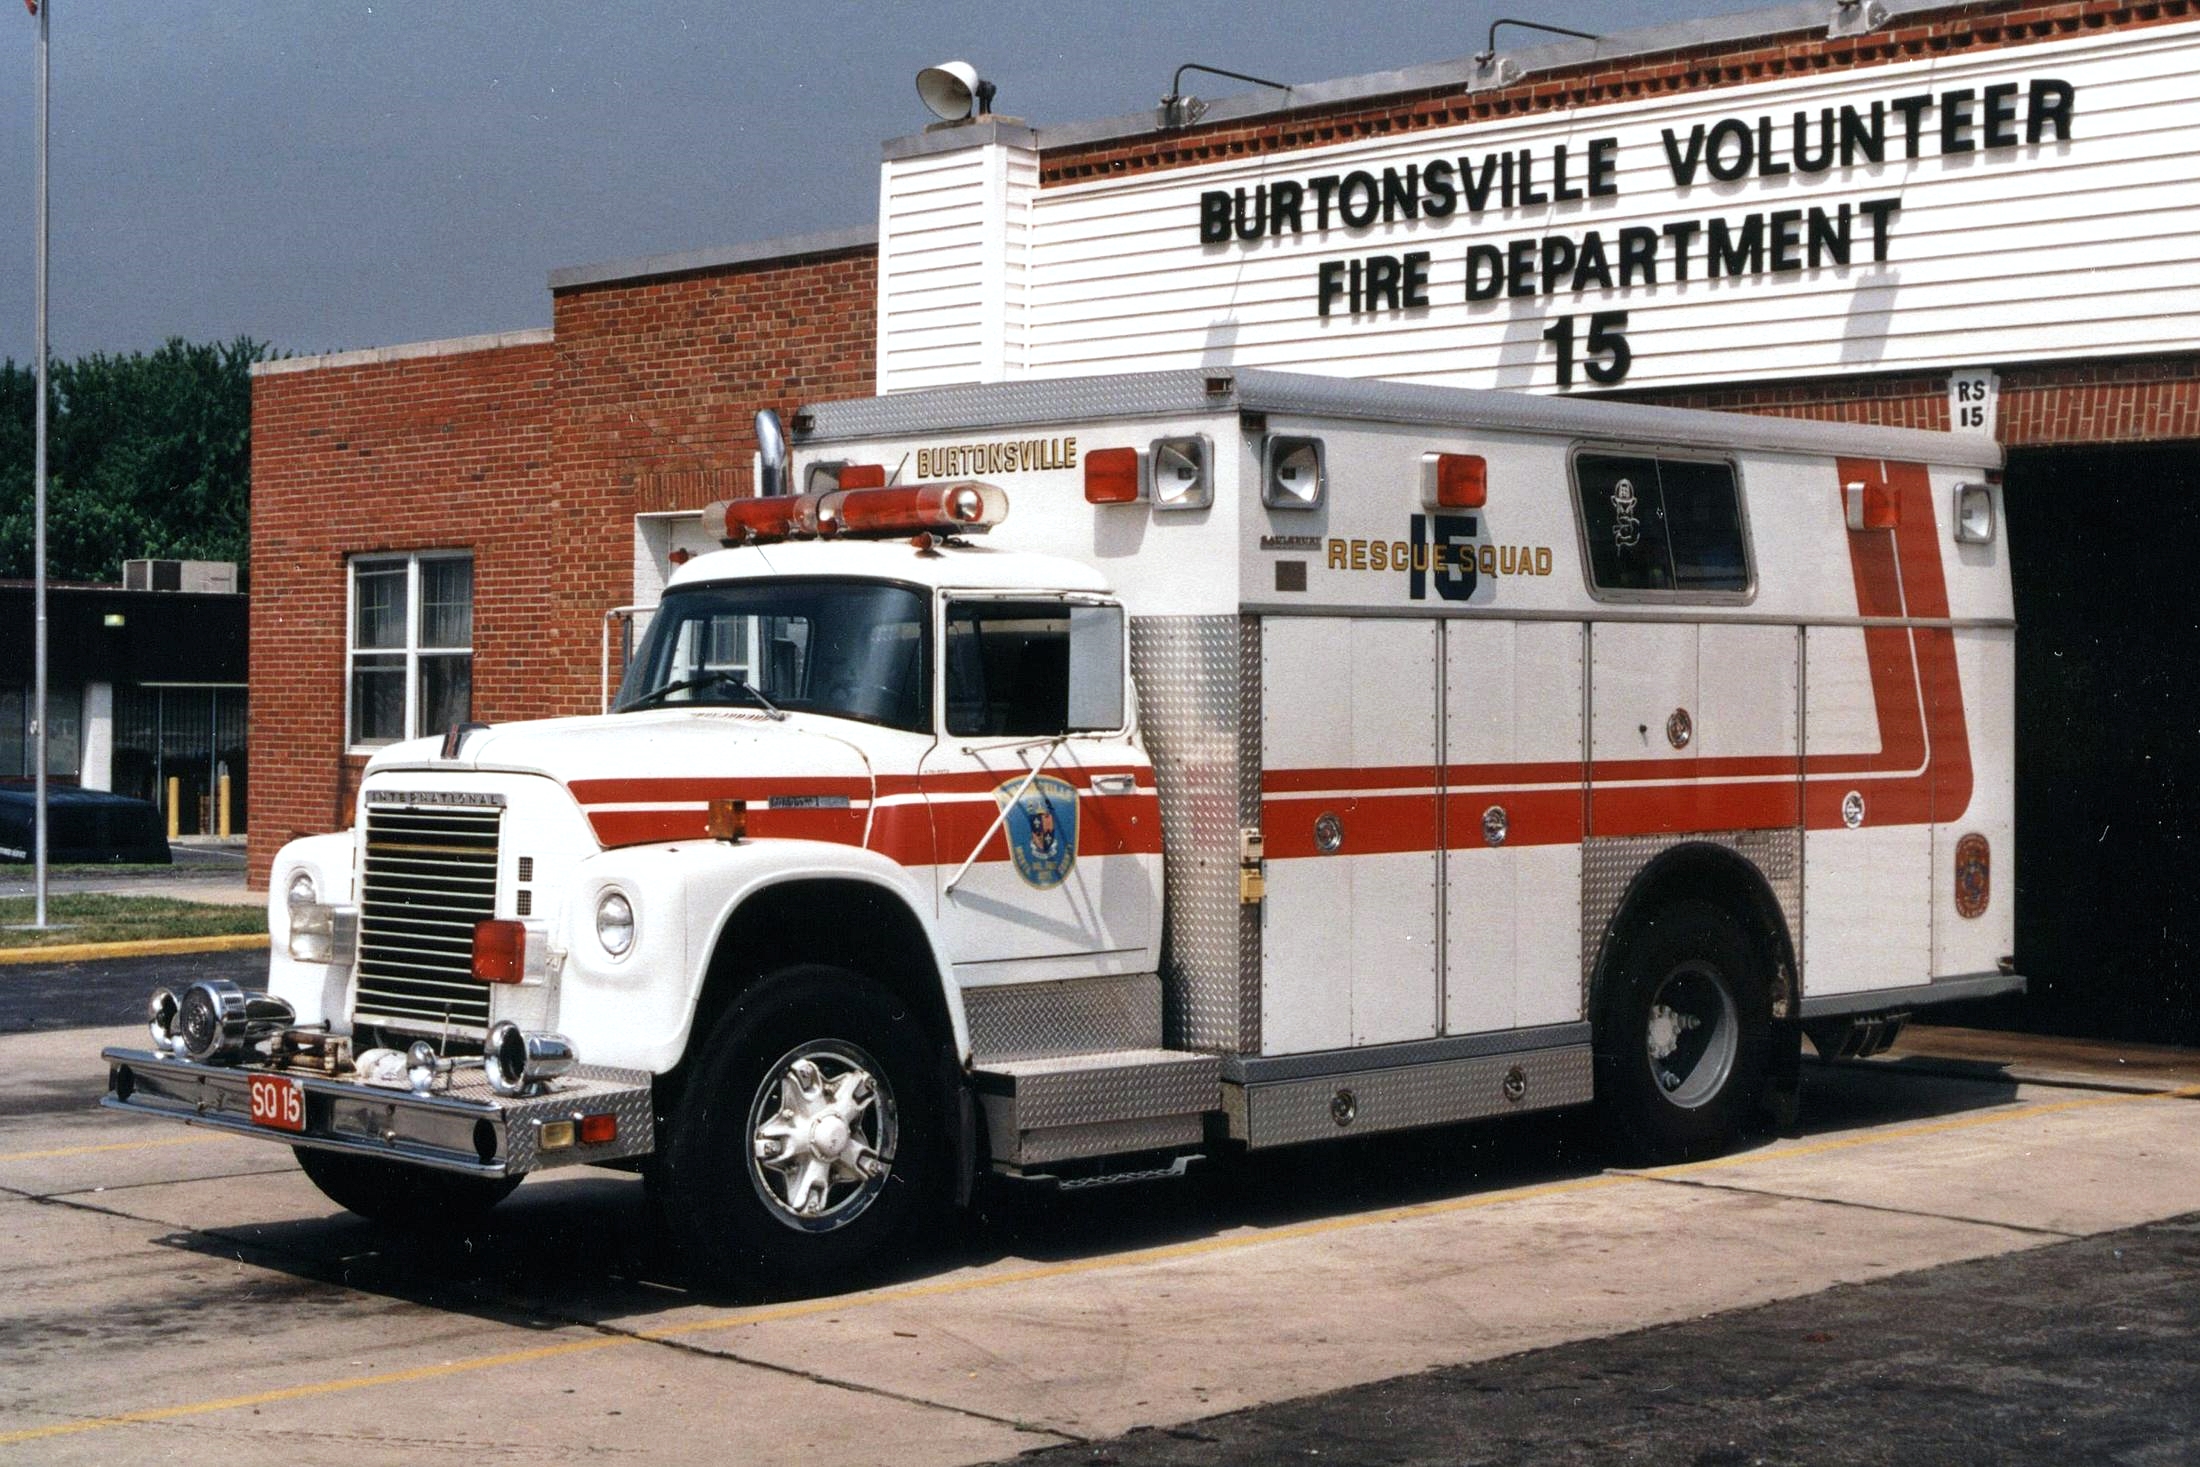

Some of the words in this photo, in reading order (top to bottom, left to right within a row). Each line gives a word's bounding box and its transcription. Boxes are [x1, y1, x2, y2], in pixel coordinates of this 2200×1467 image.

[1200, 137, 1618, 245] BURTONSVILLE
[1660, 79, 2075, 187] VOLUNTEER
[1318, 250, 1431, 317] FIRE
[1465, 197, 1902, 302] DEPARTMENT
[1543, 310, 1634, 388] 15
[1958, 379, 1985, 402] RS
[1961, 406, 1983, 427] 15
[917, 437, 1077, 478] BURTONSVILLE
[1328, 538, 1448, 572] RESCUE
[1458, 544, 1553, 578] SQUAD
[1409, 514, 1477, 601] 15
[371, 791, 499, 805] INTERNATIONAL
[252, 1081, 277, 1119] SQ
[282, 1086, 300, 1123] 15
